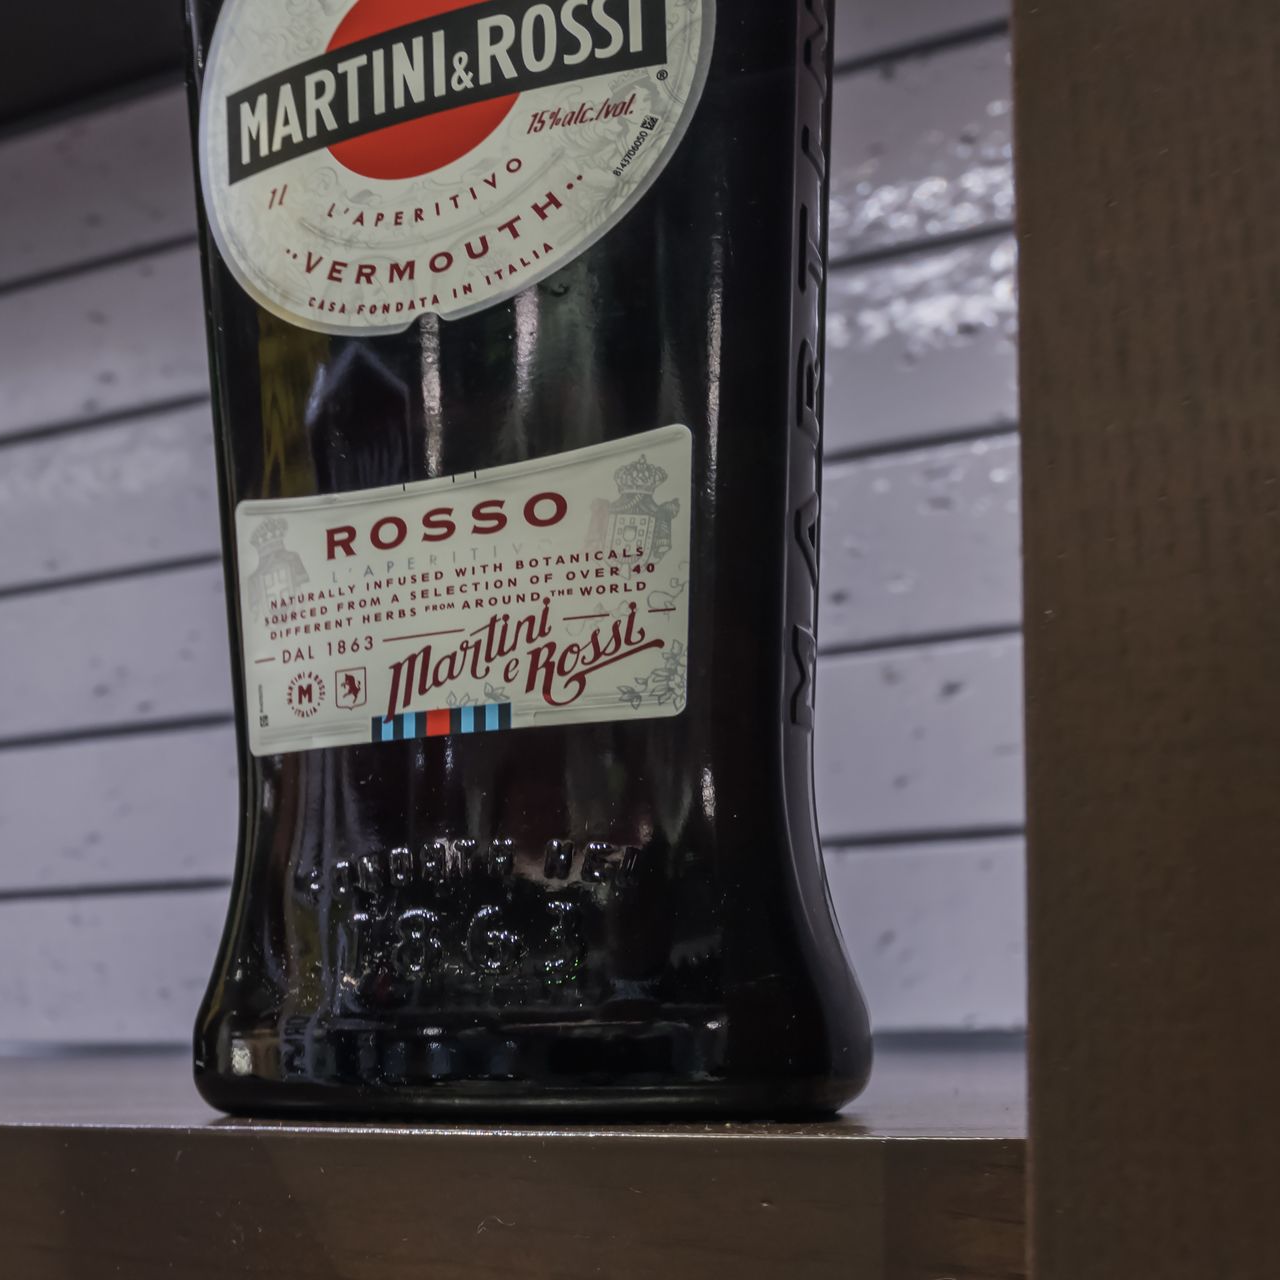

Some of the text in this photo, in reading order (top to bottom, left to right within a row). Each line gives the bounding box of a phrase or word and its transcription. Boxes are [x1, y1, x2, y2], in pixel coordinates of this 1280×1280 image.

[326, 157, 523, 227] L'APERITIVO
[303, 191, 563, 286] VERMOUTH
[307, 241, 554, 315] CASA FONDATA IN ITALIA
[325, 491, 568, 561] ROSSO
[264, 562, 656, 626] SOURCED FROM A SELECTION OF OVER 40
[270, 547, 644, 610] NATURALLY INFUSED WITH BOTANICALS
[270, 581, 647, 641] DIFFERENT HERBS FROM AROUND THE WORLD
[282, 635, 374, 664] DAL 1863
[383, 597, 552, 724] Martini
[525, 601, 665, 706] Rossi
[297, 683, 313, 705] M
